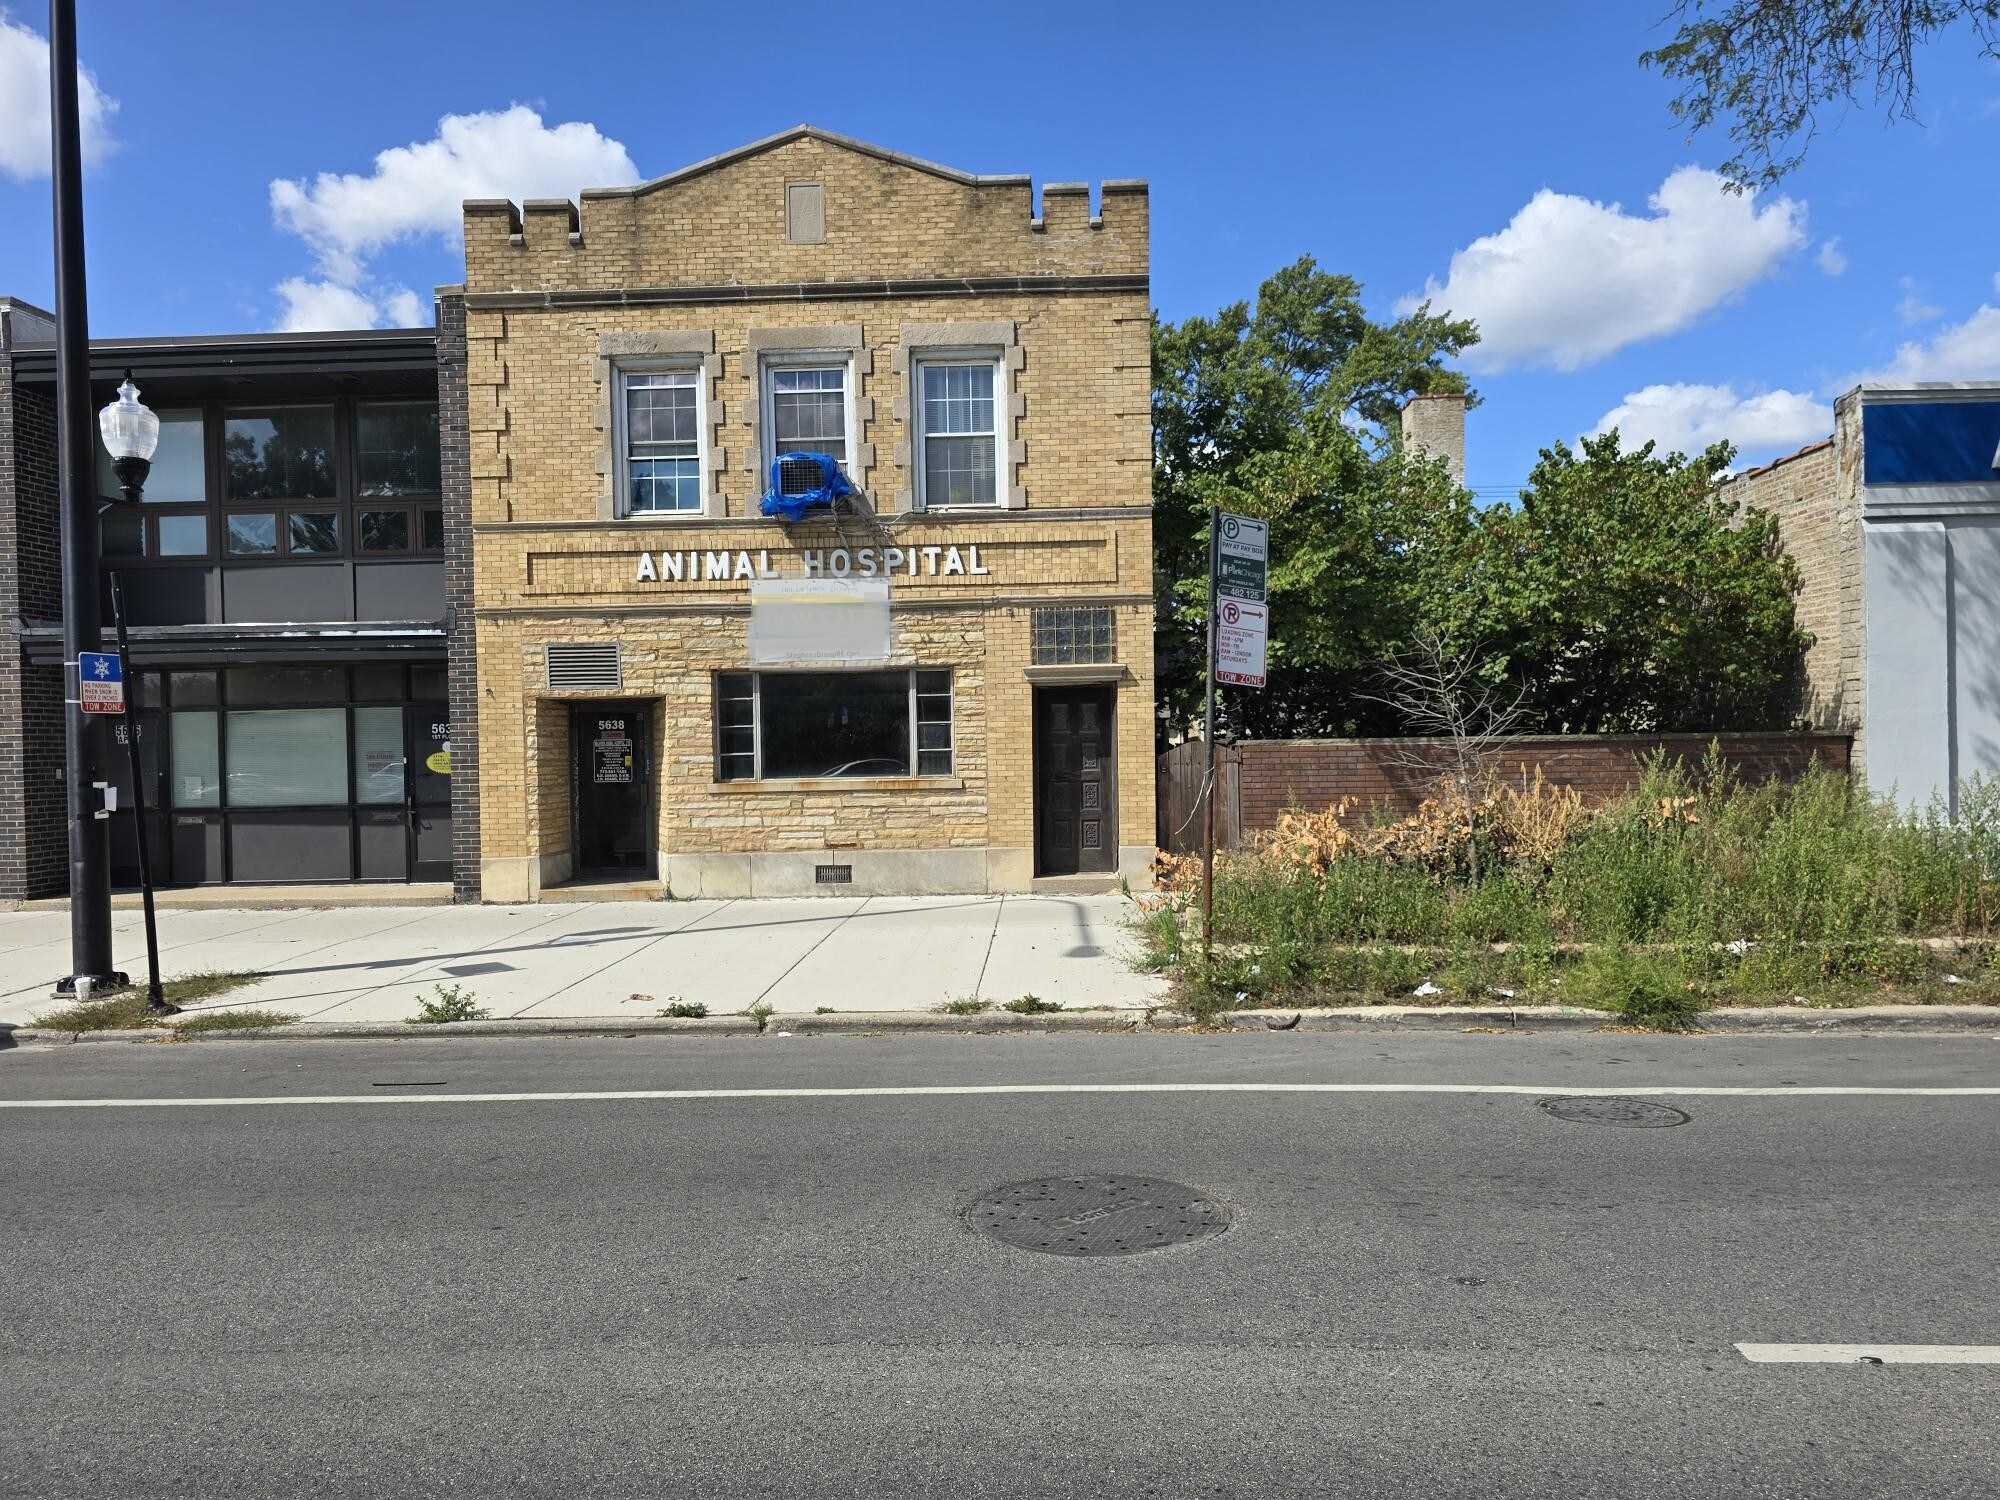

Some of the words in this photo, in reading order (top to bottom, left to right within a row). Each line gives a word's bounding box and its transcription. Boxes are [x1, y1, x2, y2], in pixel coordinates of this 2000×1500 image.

[1222, 541, 1232, 549] PAY
[637, 550, 780, 582] ANIMAL
[805, 546, 989, 578] HOSPITAL
[1230, 588, 1245, 598] 482
[1246, 591, 1260, 600] 125
[1221, 629, 1241, 637] LOADING
[1220, 672, 1236, 682] TOW
[1240, 675, 1262, 685] ZONE
[85, 702, 100, 711] TOW
[103, 702, 122, 711] ZONE
[116, 725, 140, 736] 566
[431, 723, 451, 734] 563
[598, 720, 625, 730] 5638
